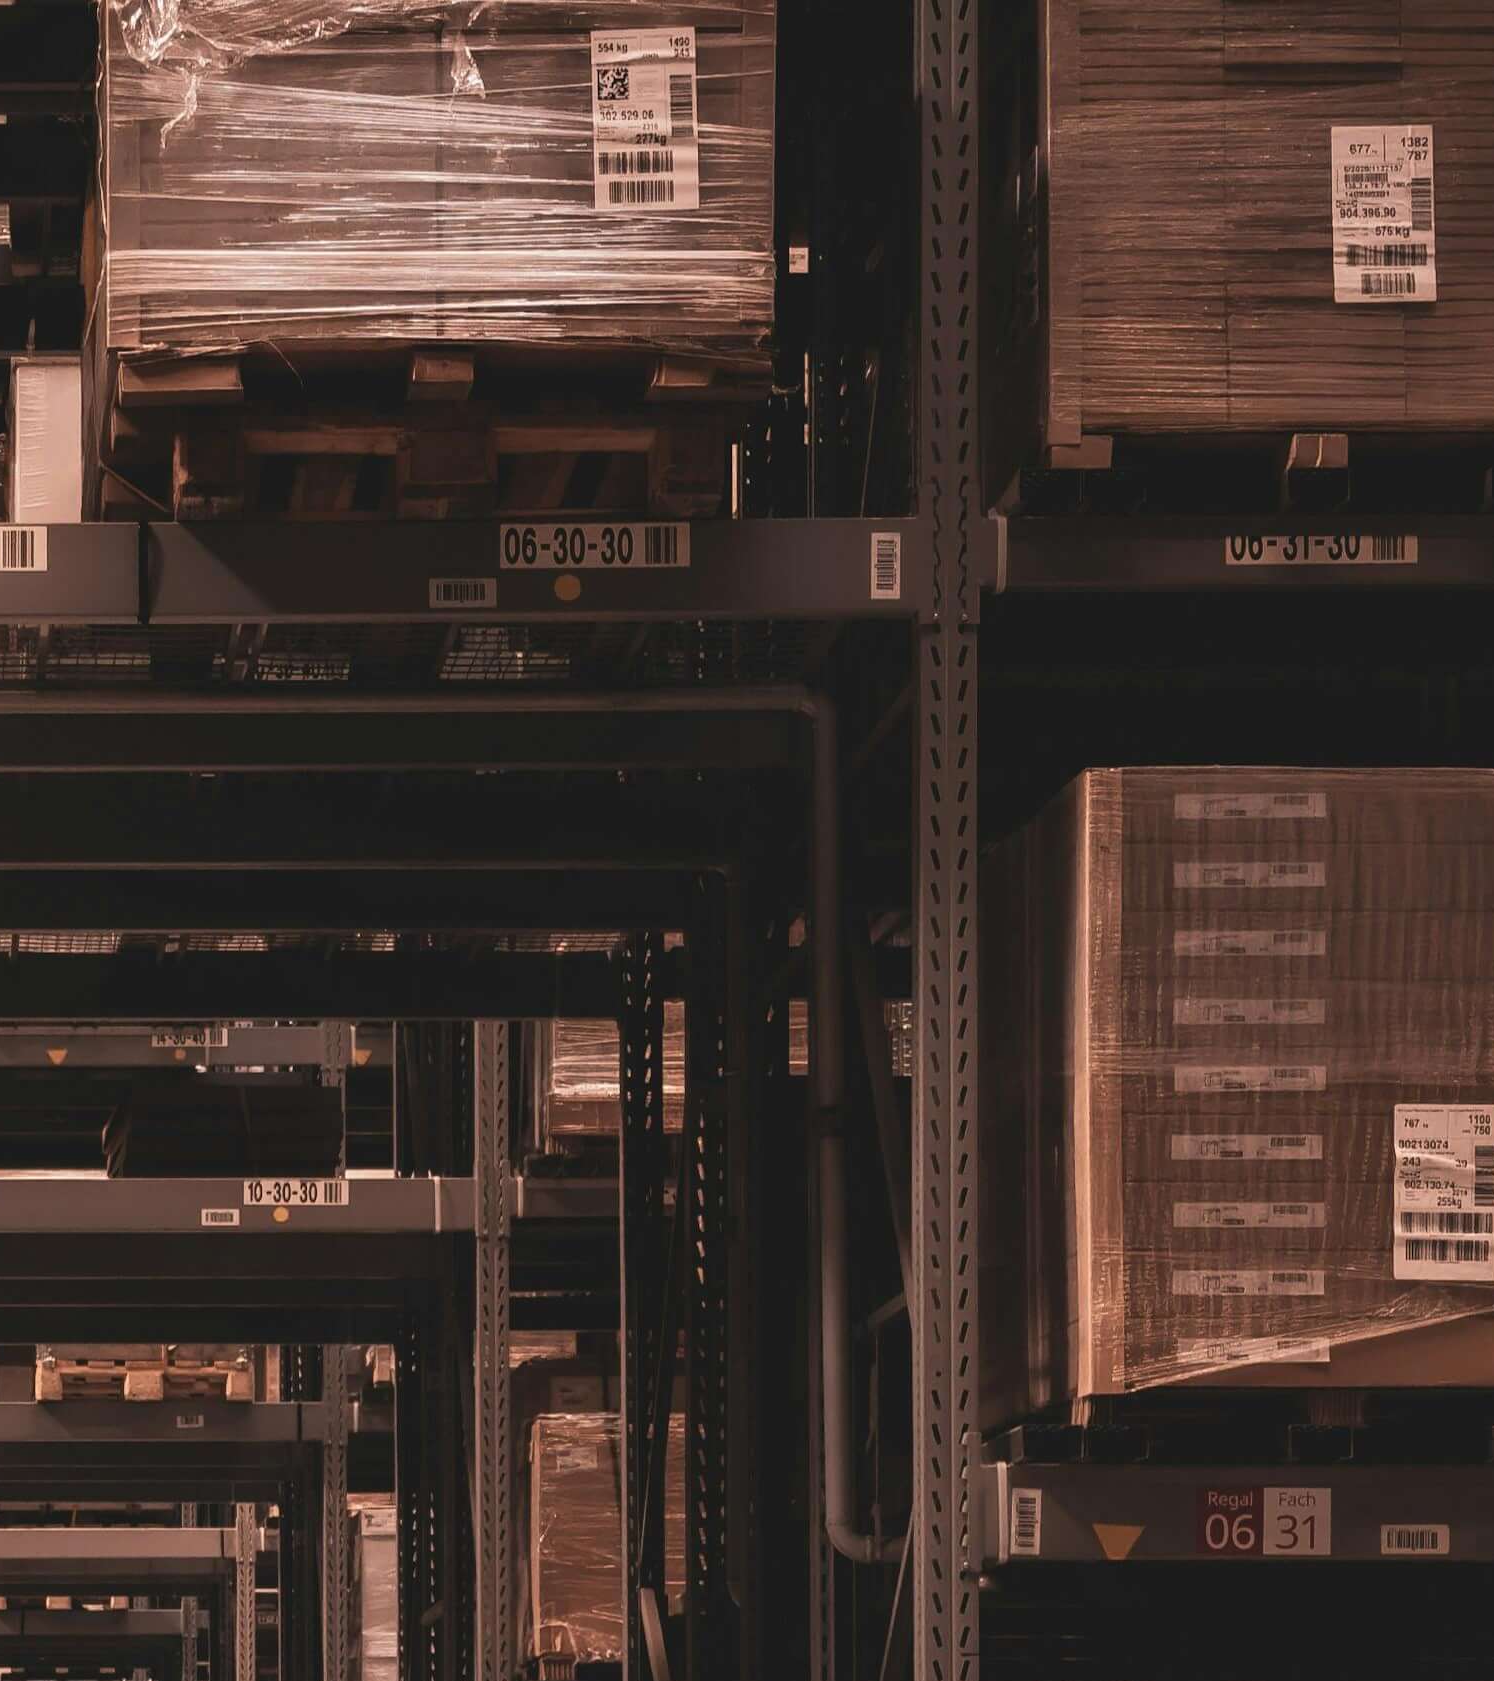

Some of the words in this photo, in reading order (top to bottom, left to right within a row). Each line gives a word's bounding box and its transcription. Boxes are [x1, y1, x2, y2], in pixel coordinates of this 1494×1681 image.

[1349, 143, 1371, 153] 677
[1400, 137, 1429, 147] 1382
[1407, 151, 1428, 161] 787
[1395, 226, 1410, 238] kg
[504, 527, 634, 565] 06-30-30
[1469, 1115, 1491, 1125] 1100
[1474, 1126, 1491, 1136] 750
[248, 1182, 318, 1203] 10-30-30
[1208, 1491, 1253, 1510] Regal
[1278, 1492, 1316, 1506] Fach
[1205, 1513, 1255, 1550] 06
[1276, 1515, 1316, 1549] 31
